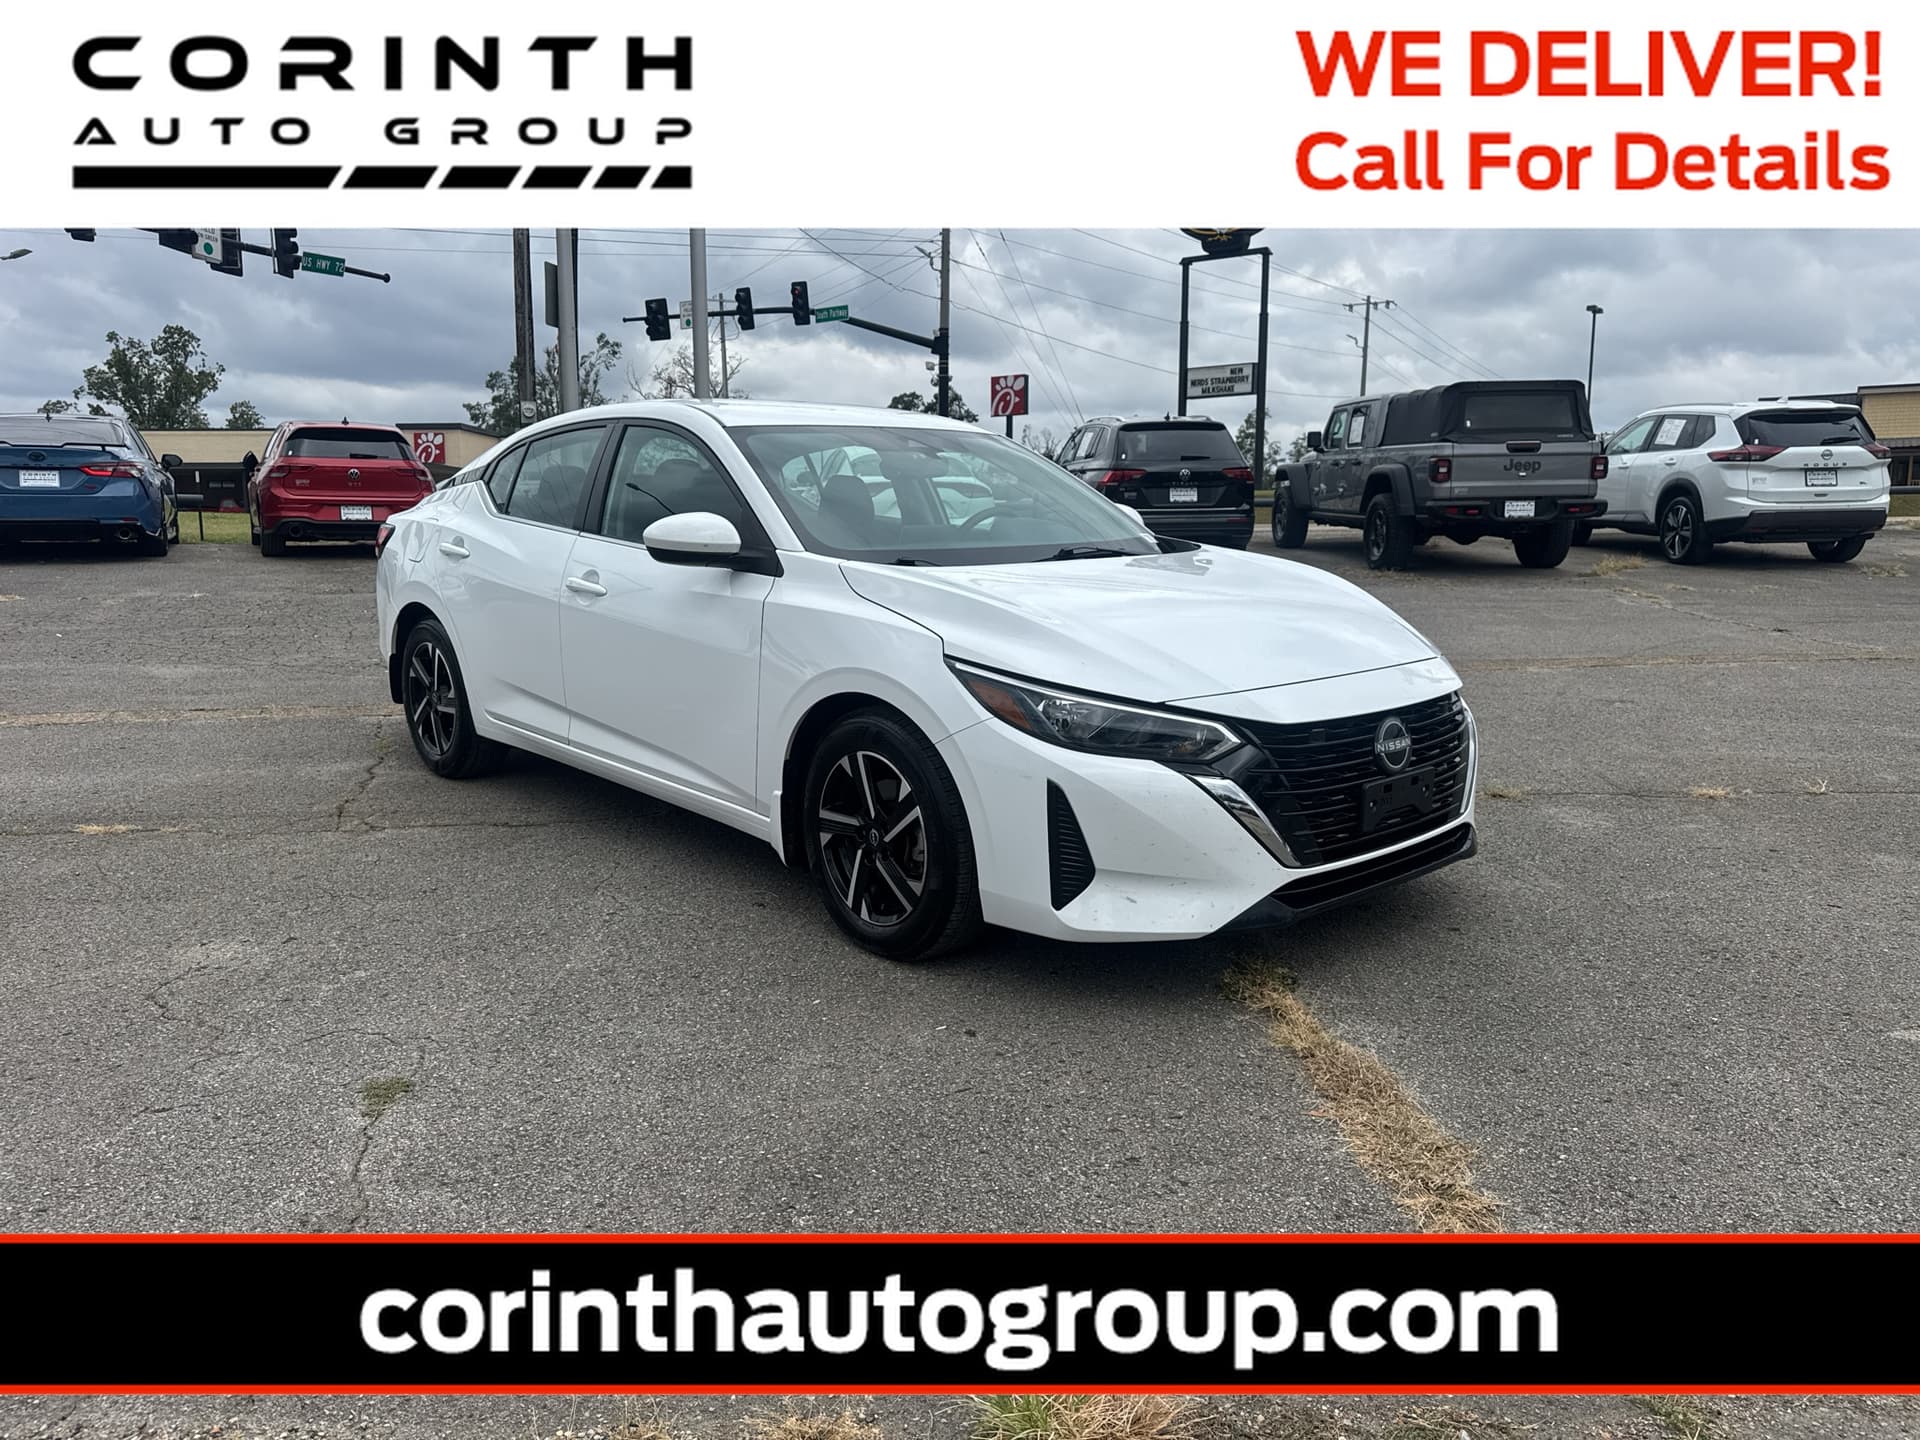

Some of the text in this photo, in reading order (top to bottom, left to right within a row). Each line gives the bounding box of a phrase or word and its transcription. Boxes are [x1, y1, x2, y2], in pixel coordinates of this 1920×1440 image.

[303, 257, 344, 273] US HWY 72
[1230, 367, 1243, 375] NEW
[1201, 385, 1235, 394] MILKSHAKE
[1503, 458, 1541, 473] Jeep
[1376, 736, 1411, 753] NISSAN
